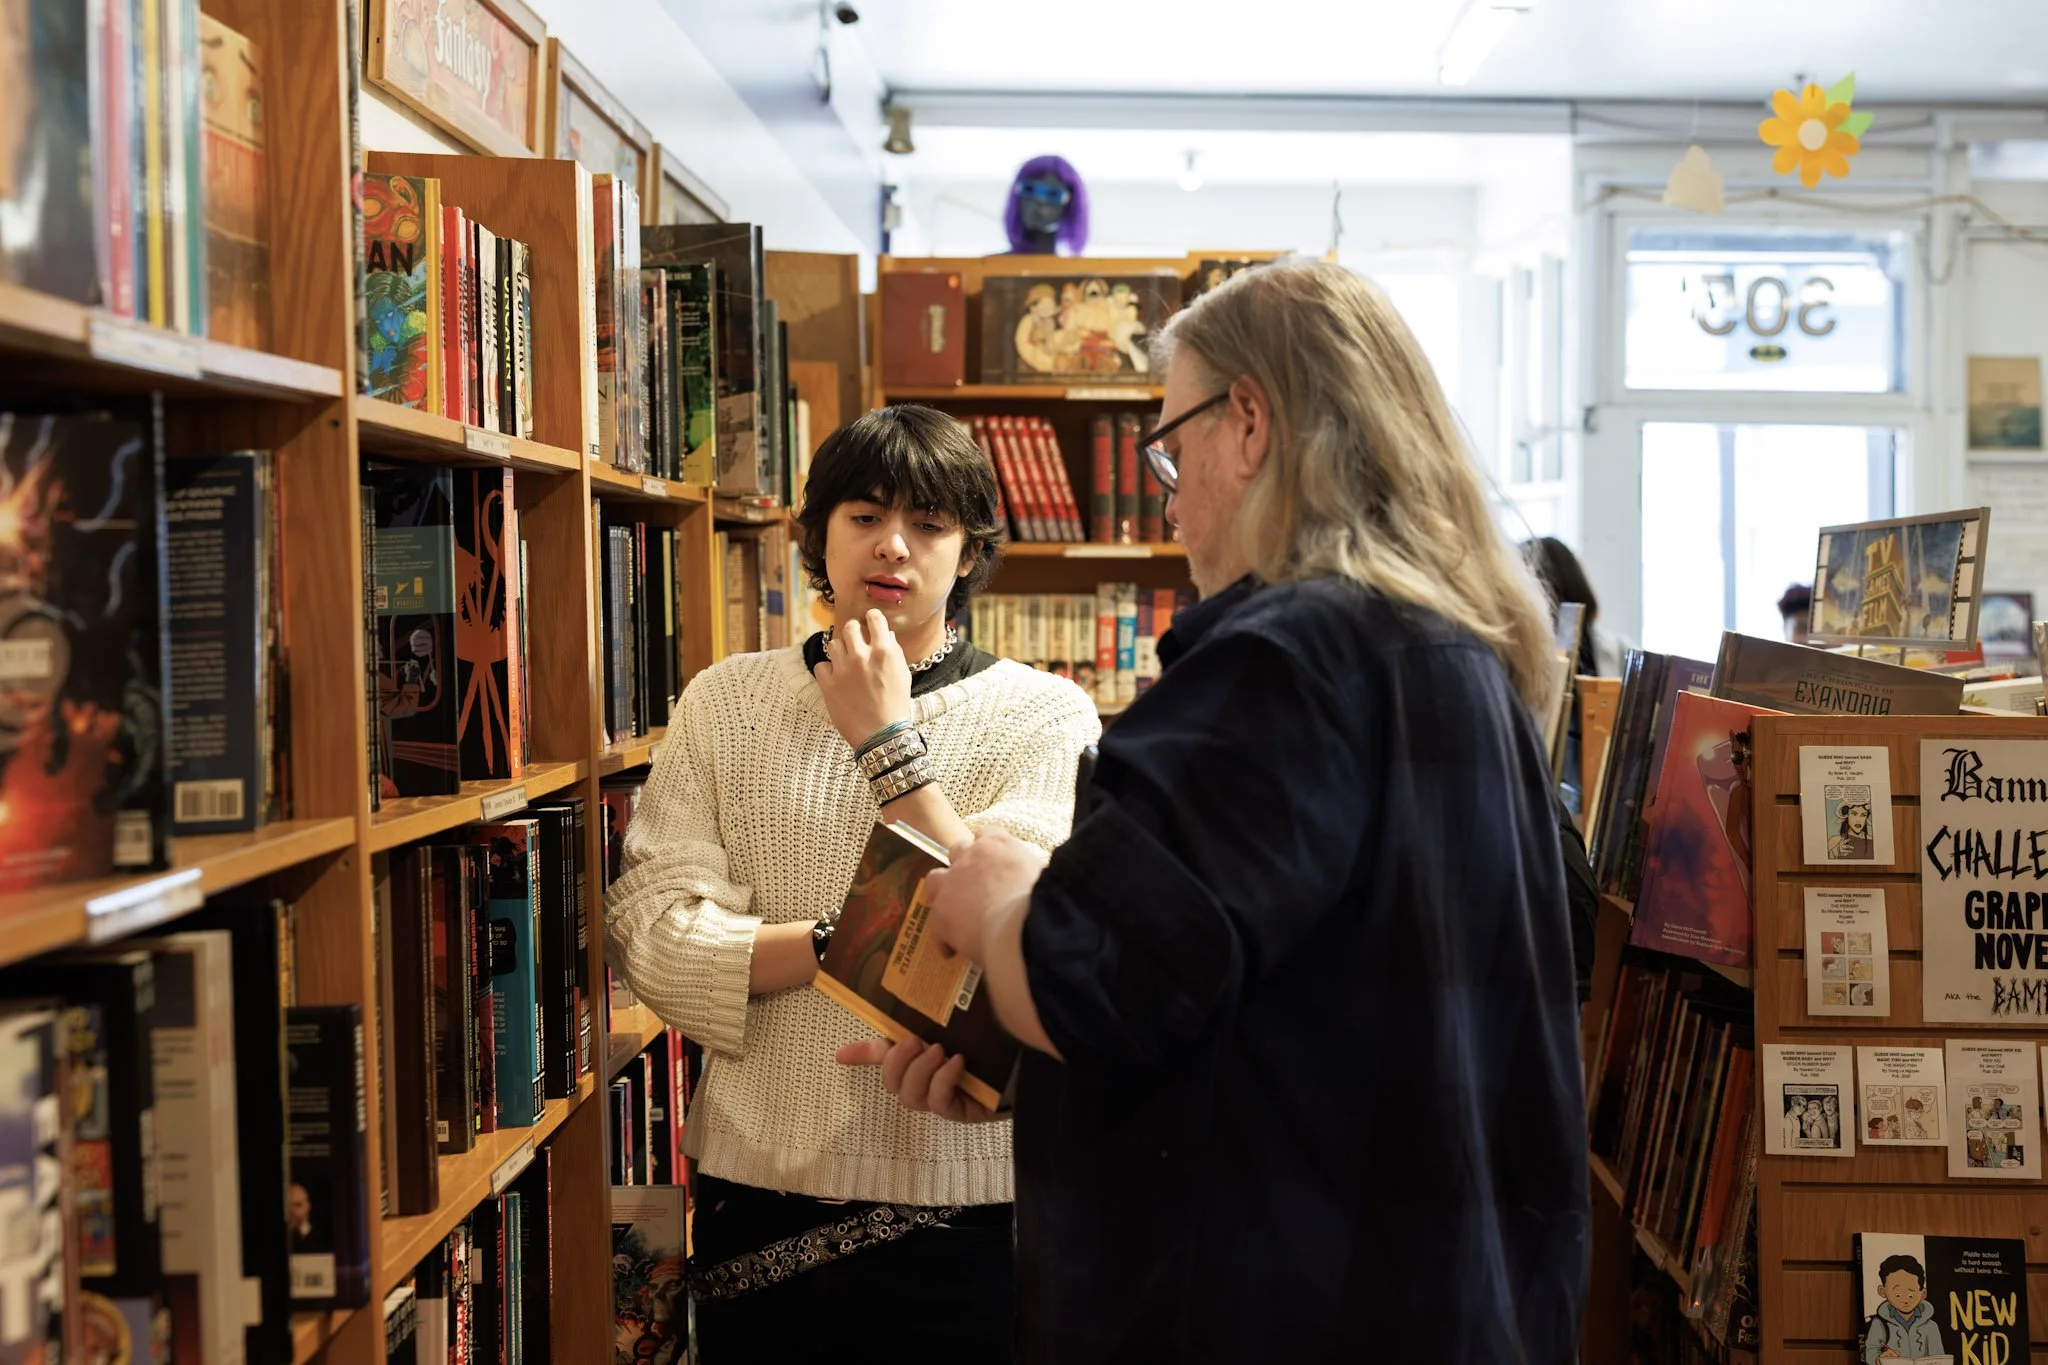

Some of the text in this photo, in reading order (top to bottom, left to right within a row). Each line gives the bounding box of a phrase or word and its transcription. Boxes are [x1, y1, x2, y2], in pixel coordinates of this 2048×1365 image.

[1865, 532, 1895, 572] TV
[1795, 680, 1893, 715] EXANDRIA
[1974, 933, 2048, 970] NOVE
[1944, 993, 1960, 1001] AKA
[1976, 1267, 1991, 1275] being
[1949, 1289, 2017, 1331] NEW
[456, 1304, 464, 1359] HACK
